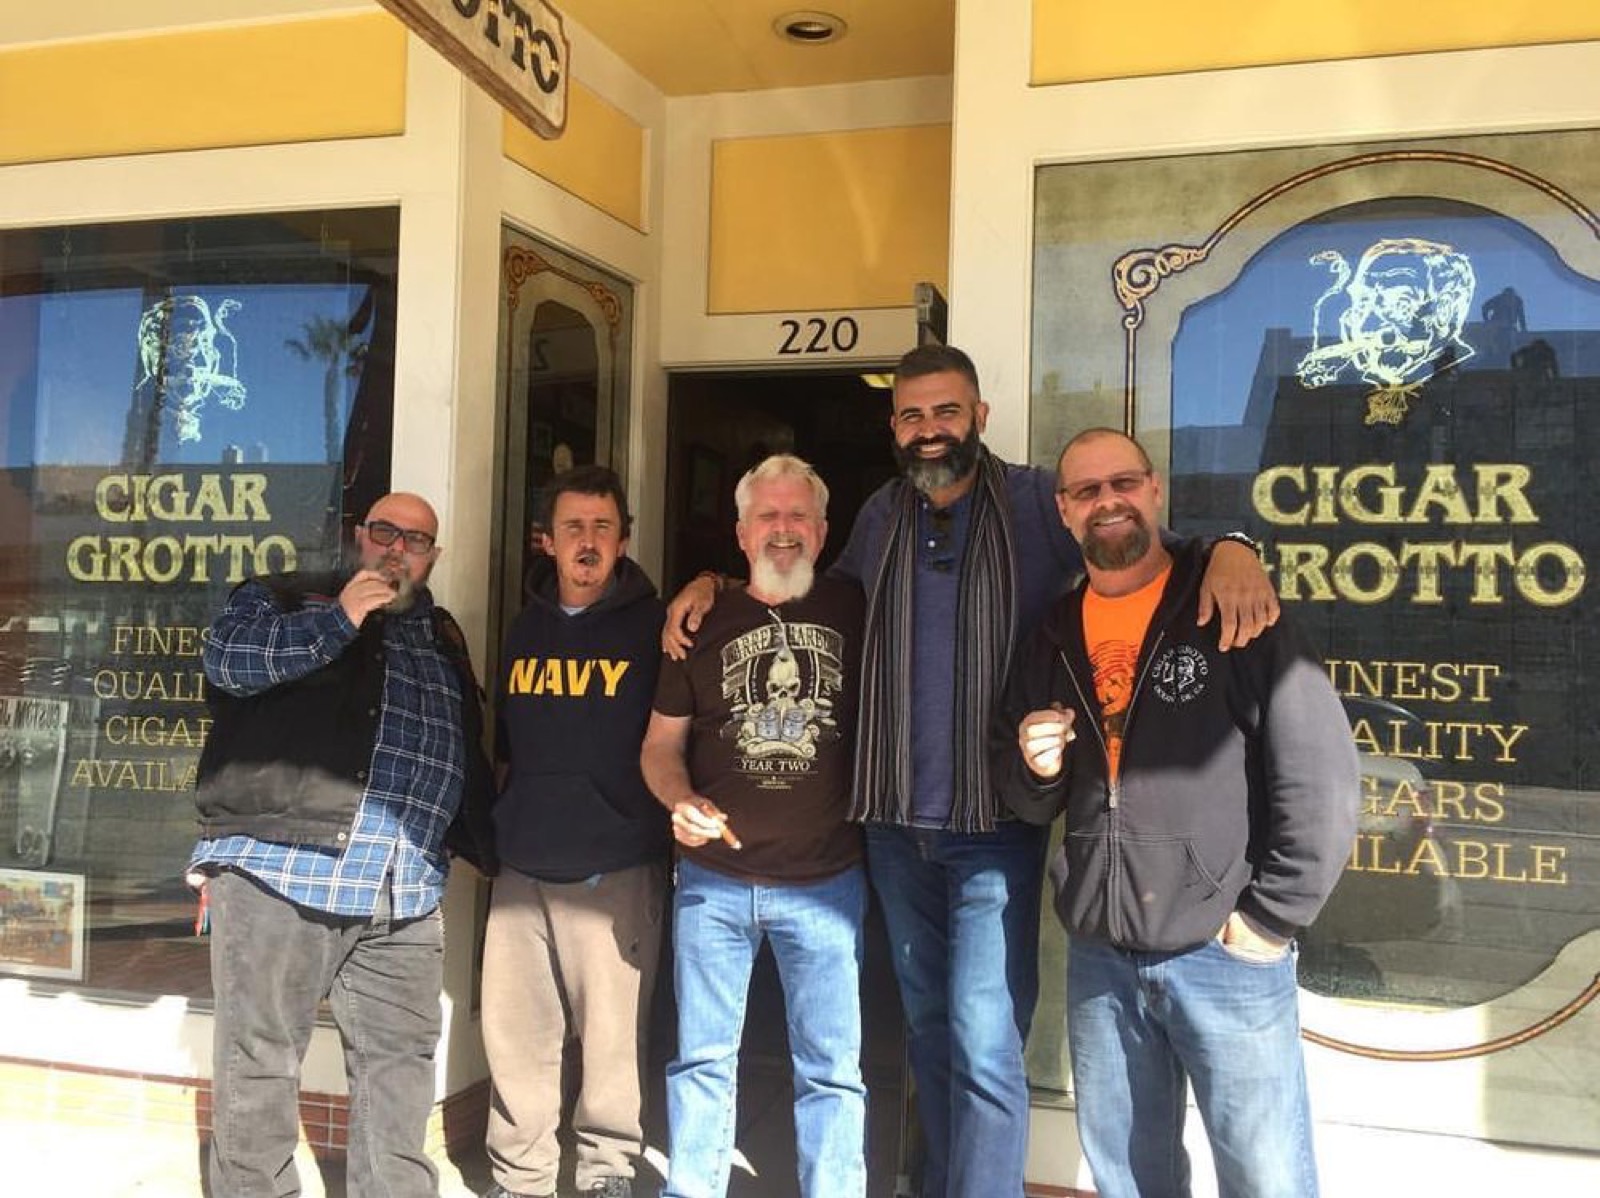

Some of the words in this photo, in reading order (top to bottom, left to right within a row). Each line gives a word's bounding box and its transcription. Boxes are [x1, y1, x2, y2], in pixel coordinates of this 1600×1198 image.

[453, 0, 560, 93] TTO
[778, 317, 859, 355] 220
[95, 473, 271, 522] CIGAR
[1252, 462, 1539, 526] CIGAR
[66, 533, 298, 583] GROTTO
[1257, 540, 1586, 606] ROTTO
[509, 658, 630, 696] NAVY
[741, 759, 774, 771] YEAR
[778, 760, 811, 772] TWO
